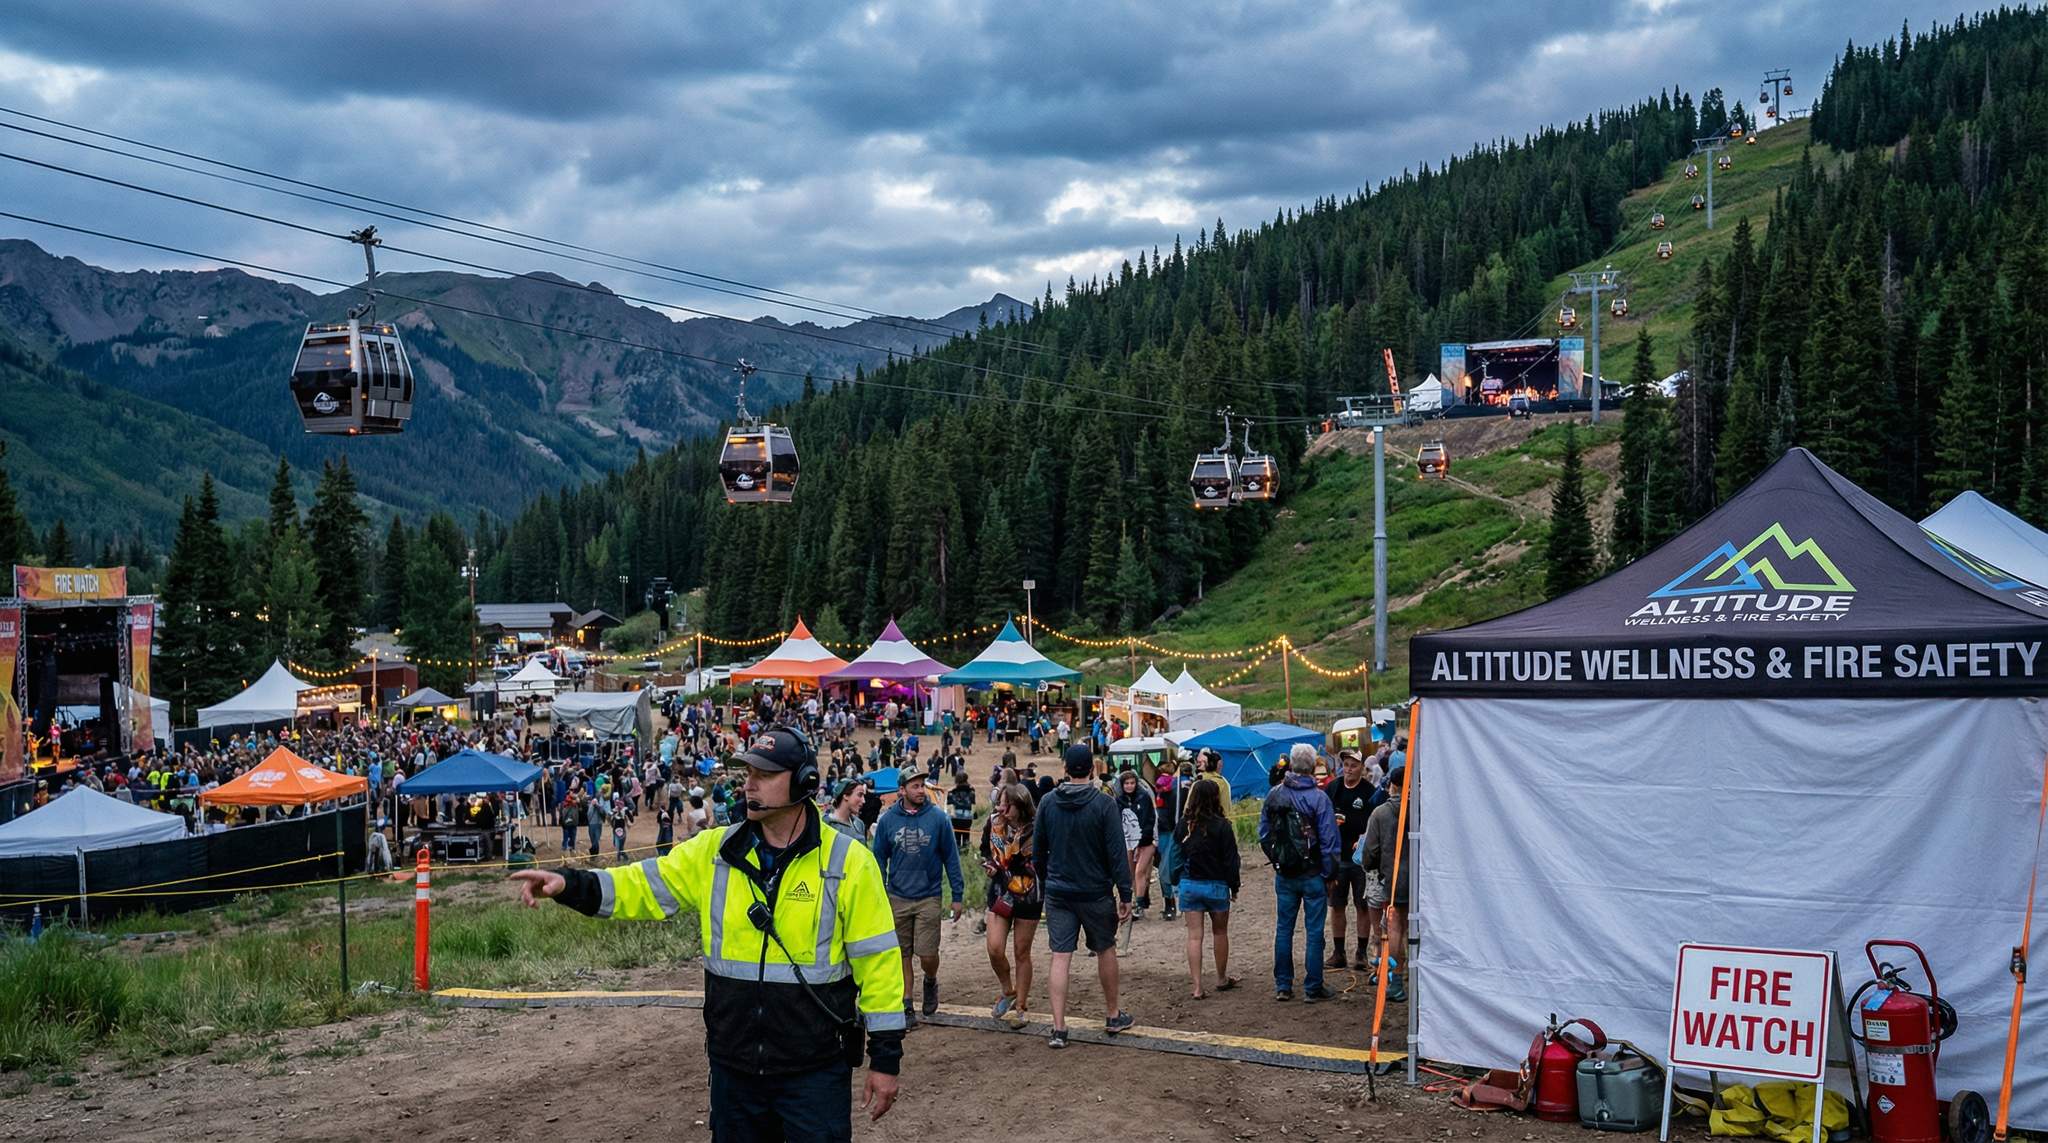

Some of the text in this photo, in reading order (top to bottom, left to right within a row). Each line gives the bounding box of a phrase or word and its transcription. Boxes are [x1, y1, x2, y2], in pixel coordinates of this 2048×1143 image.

[54, 574, 100, 594] FIRE WATCH
[1624, 613, 1847, 626] WELLNESS & FIRE SAFETY
[1629, 594, 1854, 618] ALTITUDE
[1431, 641, 2042, 681] ALTITUDE WELLNESS & FIRE SAFETY
[1710, 966, 1793, 1007] FIRE
[1683, 1010, 1815, 1058] WATCH
